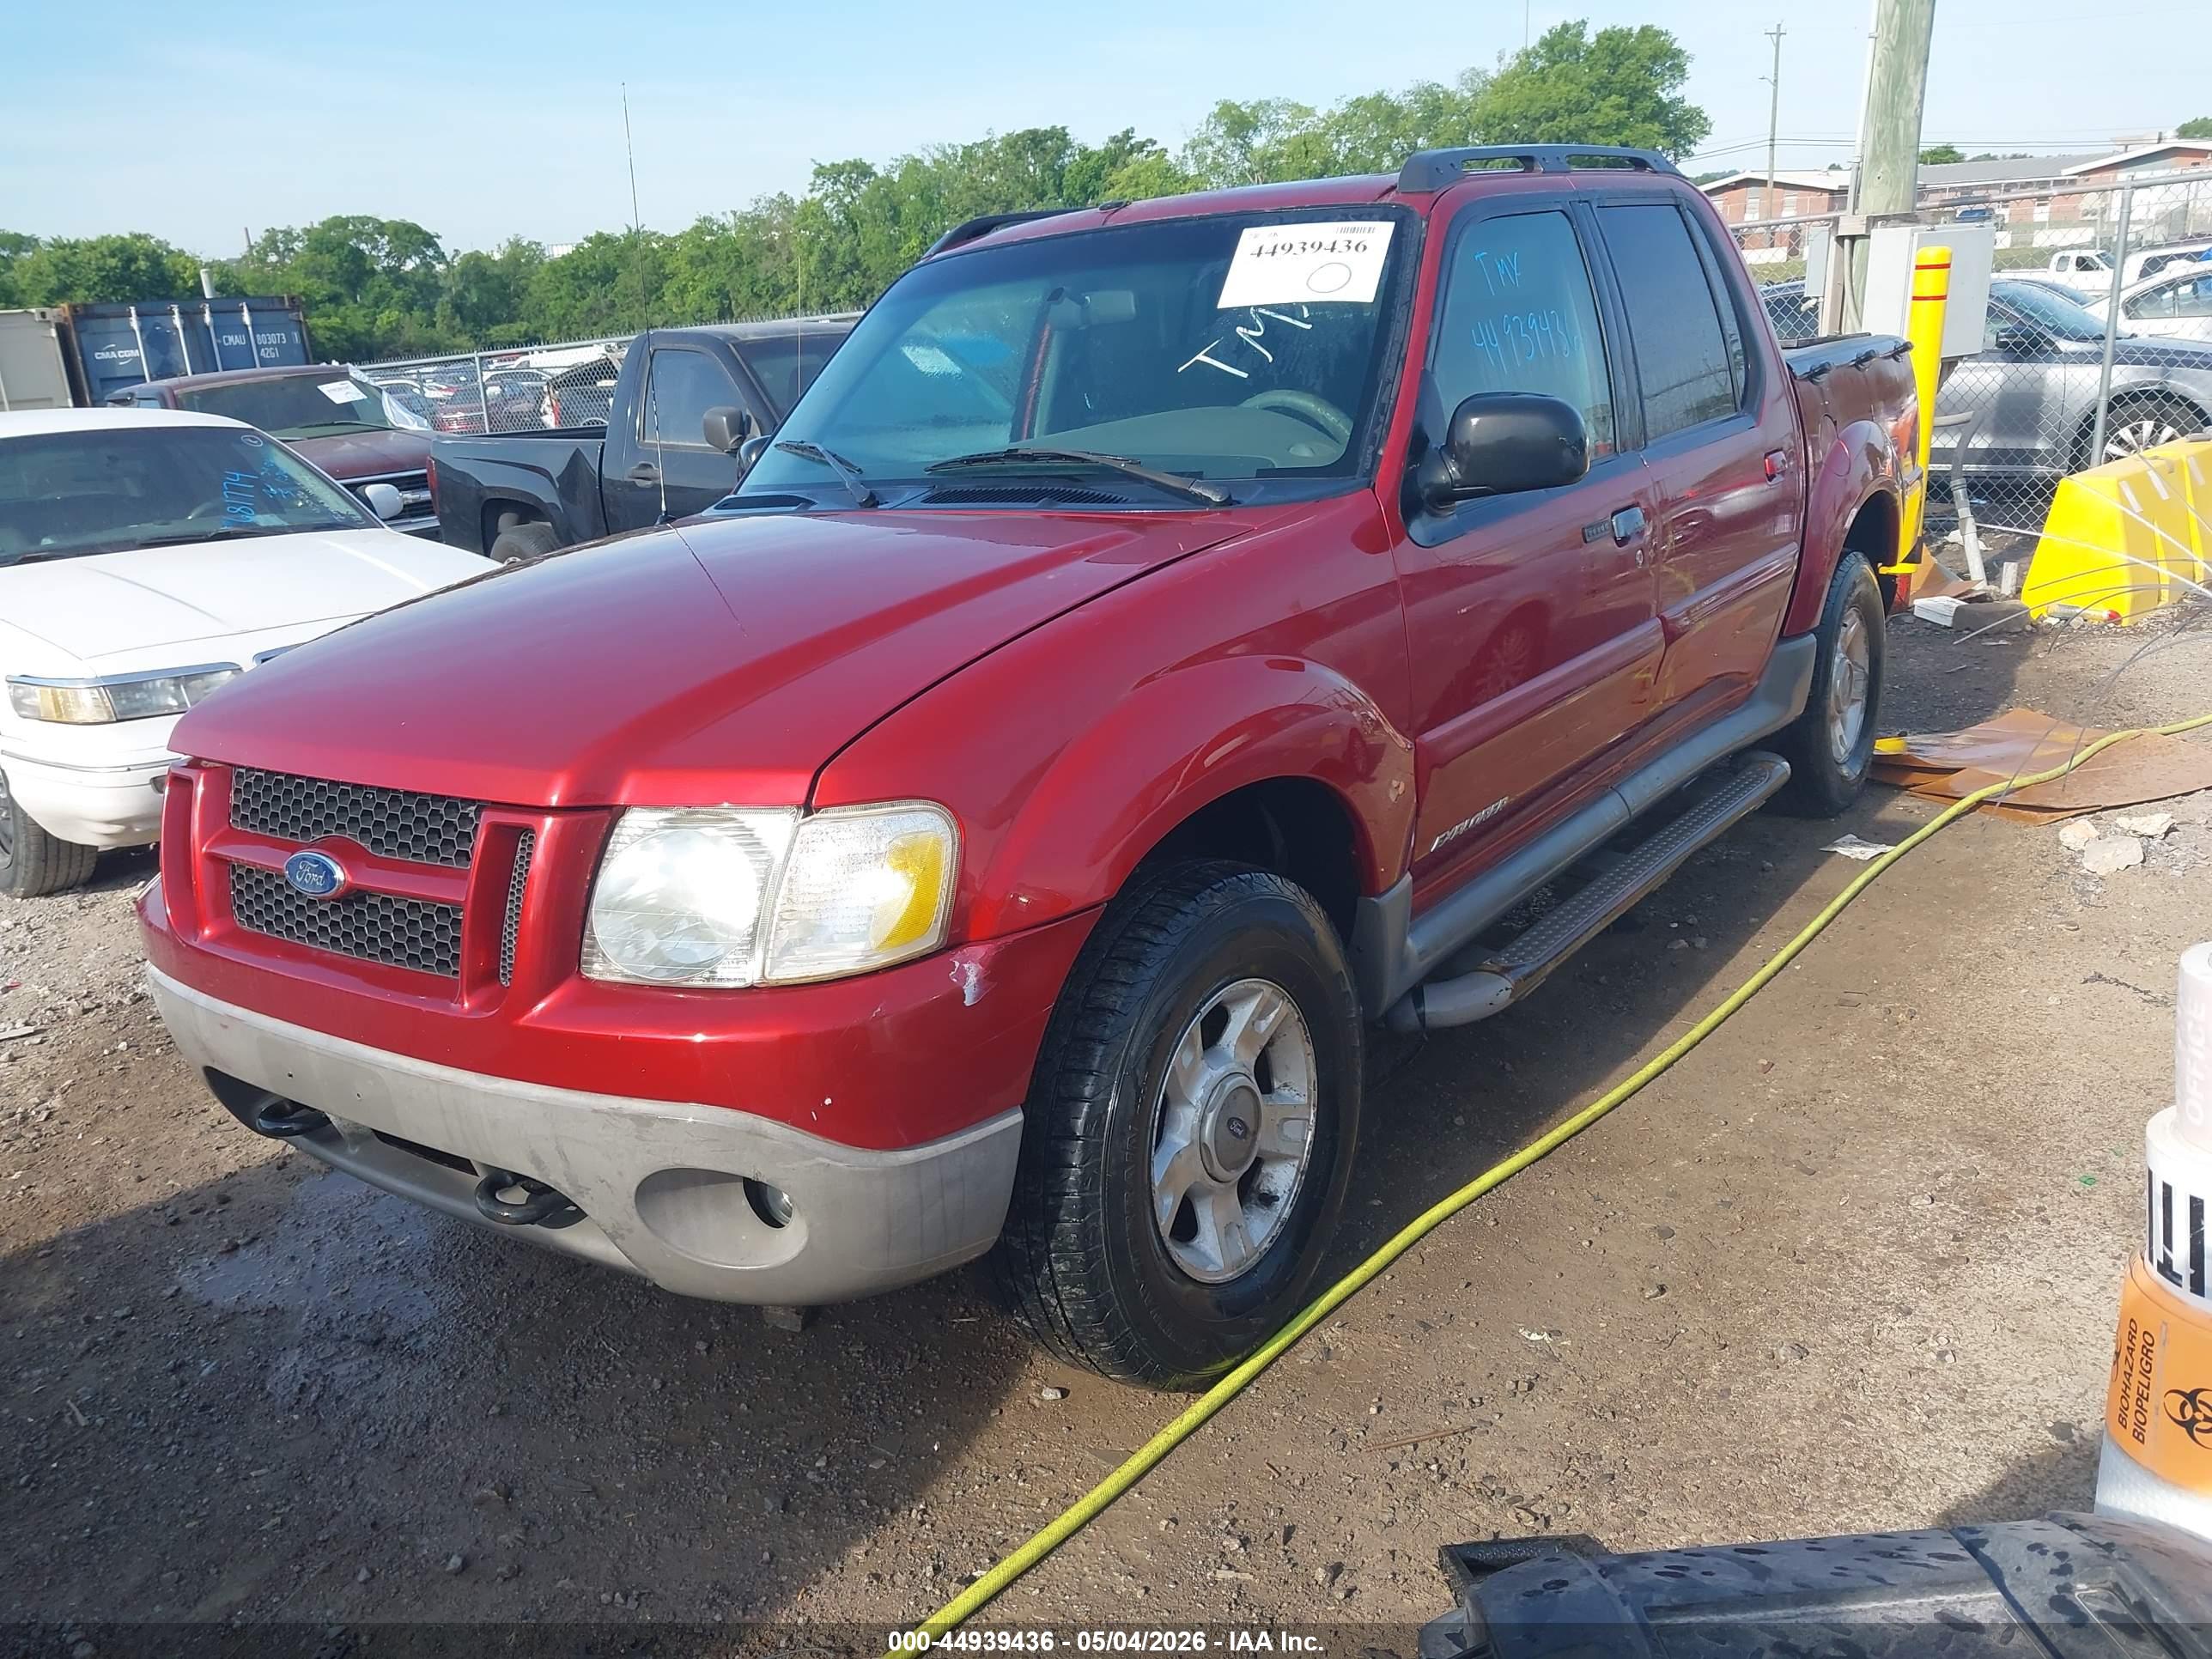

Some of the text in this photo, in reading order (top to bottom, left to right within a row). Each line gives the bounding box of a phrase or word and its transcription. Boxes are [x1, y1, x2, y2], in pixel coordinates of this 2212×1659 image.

[1250, 240, 1369, 258] 44939436
[222, 334, 246, 347] CMAU
[256, 331, 287, 345] 803073
[94, 349, 140, 361] CMA CGM
[260, 346, 280, 359] 42G1
[295, 860, 326, 887] Ford
[2117, 1317, 2139, 1431] BIOHAZARD
[2132, 1330, 2156, 1446] BIOPELIGRO
